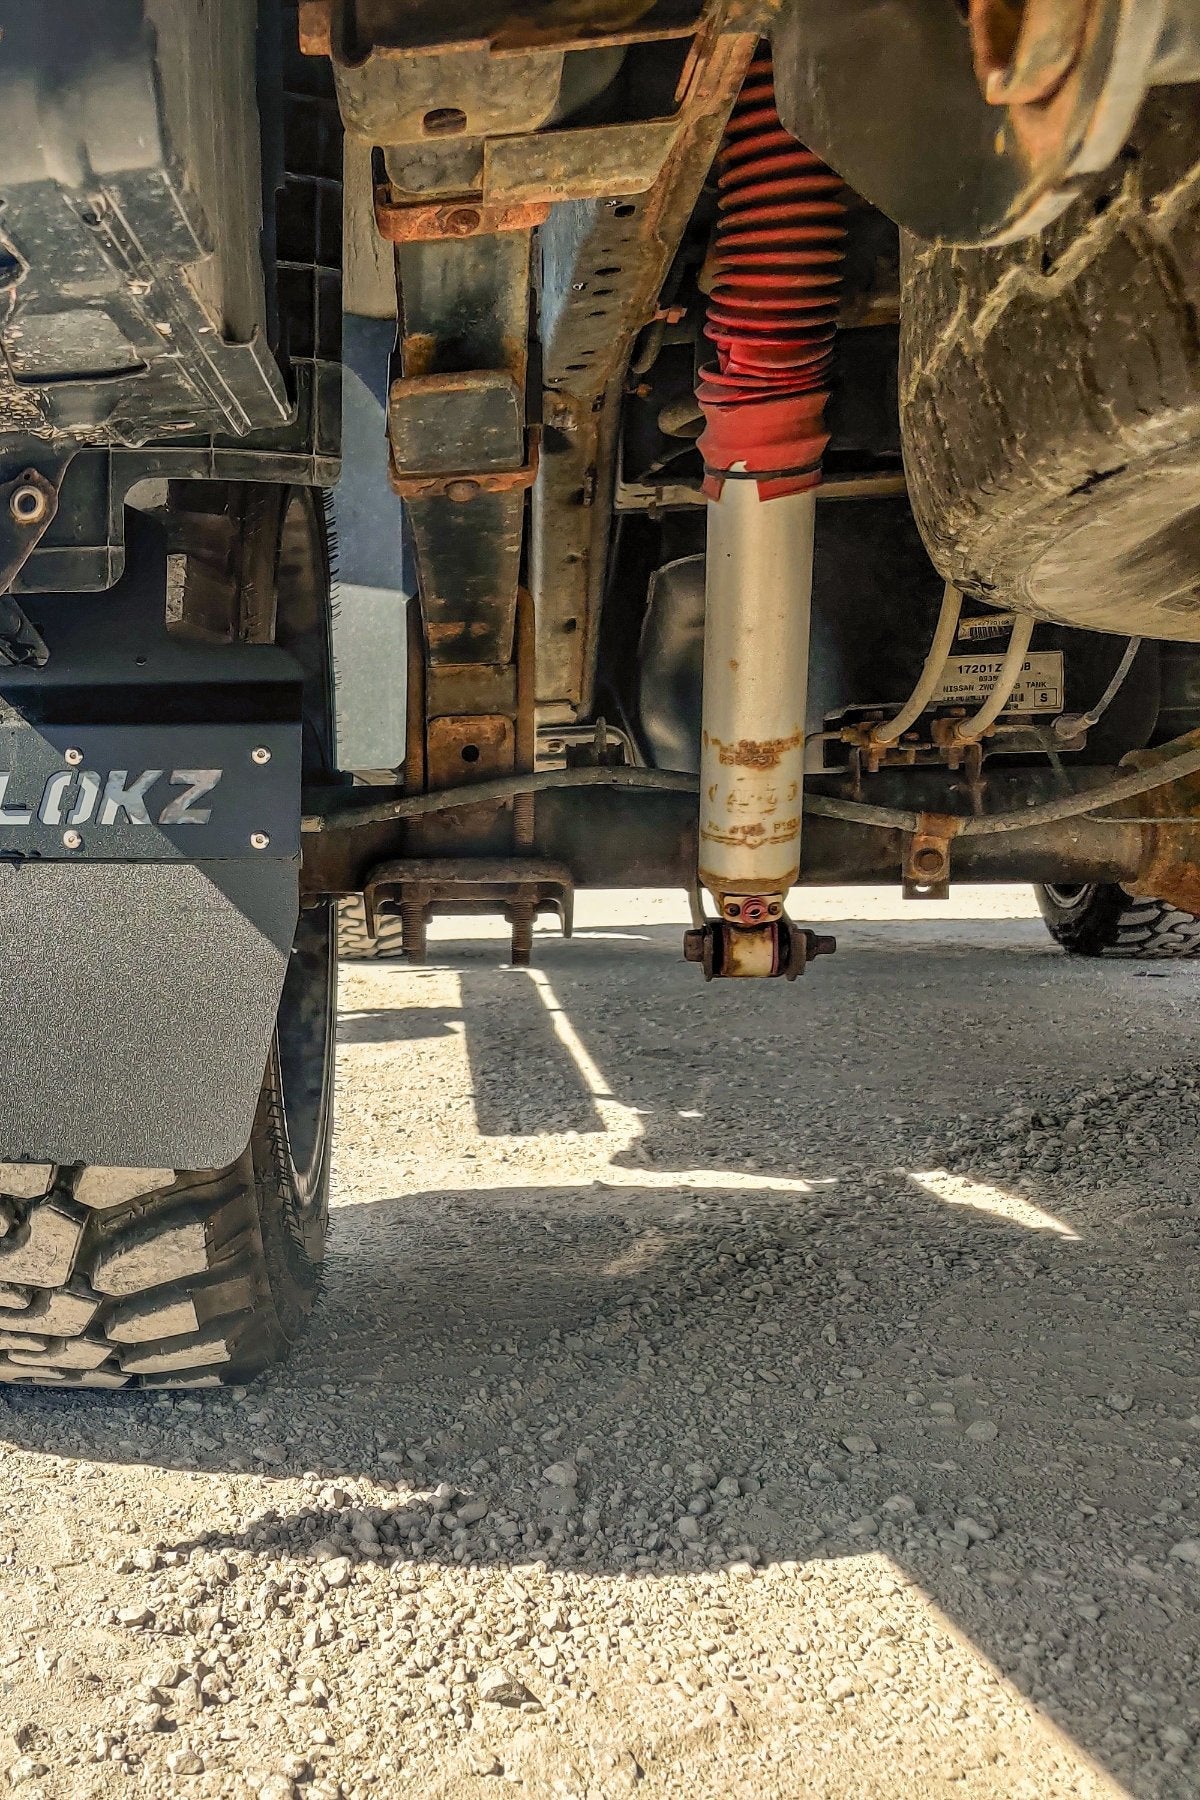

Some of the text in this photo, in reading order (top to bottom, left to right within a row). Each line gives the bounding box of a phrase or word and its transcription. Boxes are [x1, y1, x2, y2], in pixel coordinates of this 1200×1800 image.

[943, 683, 974, 693] NISSAN
[1025, 681, 1047, 689] TANK
[1039, 693, 1048, 702] S
